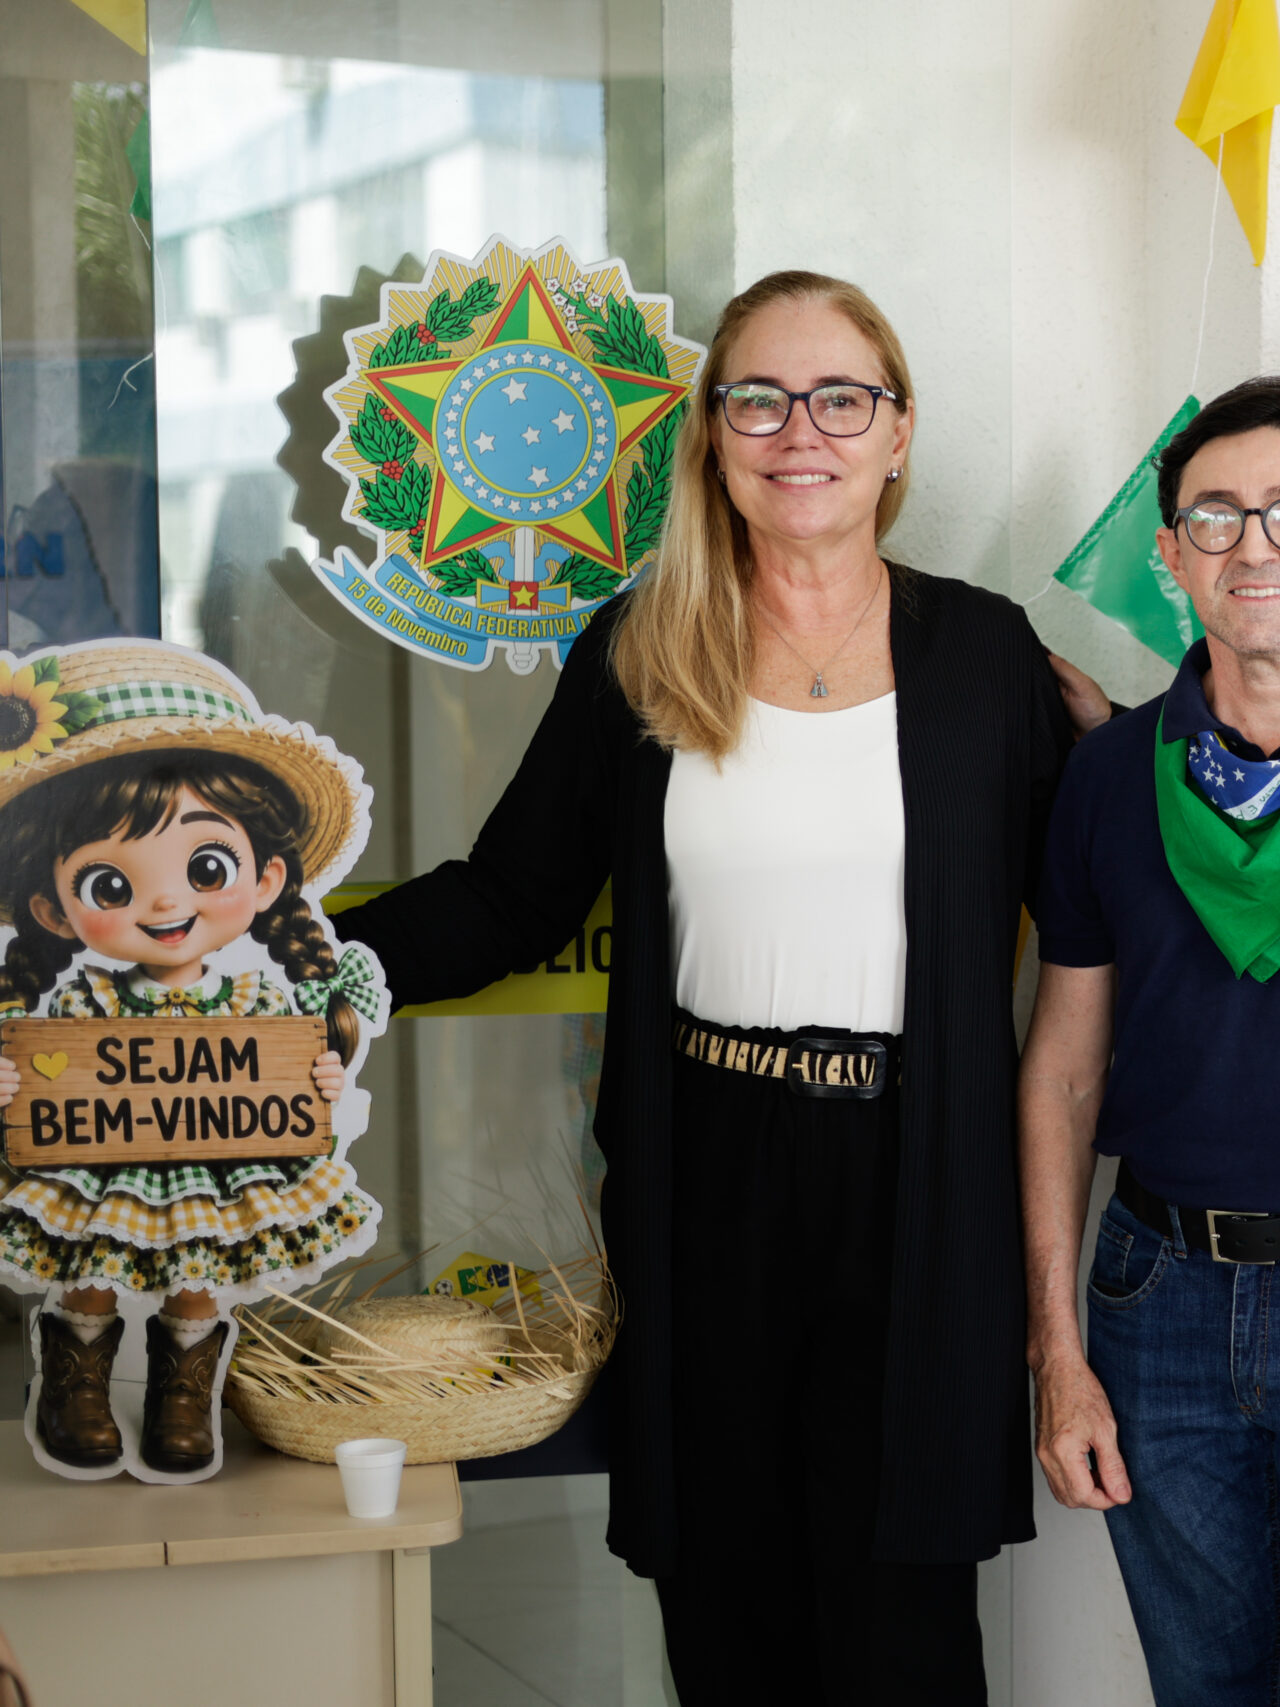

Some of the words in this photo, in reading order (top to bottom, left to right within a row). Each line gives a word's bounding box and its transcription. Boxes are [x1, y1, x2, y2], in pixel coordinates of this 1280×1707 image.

[346, 577, 371, 600] 15
[364, 595, 387, 617] de
[386, 608, 469, 657] Novembro
[476, 614, 577, 638] FEDERATIVA
[579, 609, 597, 631] D
[96, 1036, 260, 1086] SEJAM
[30, 1093, 316, 1147] BEM-VINDOS
